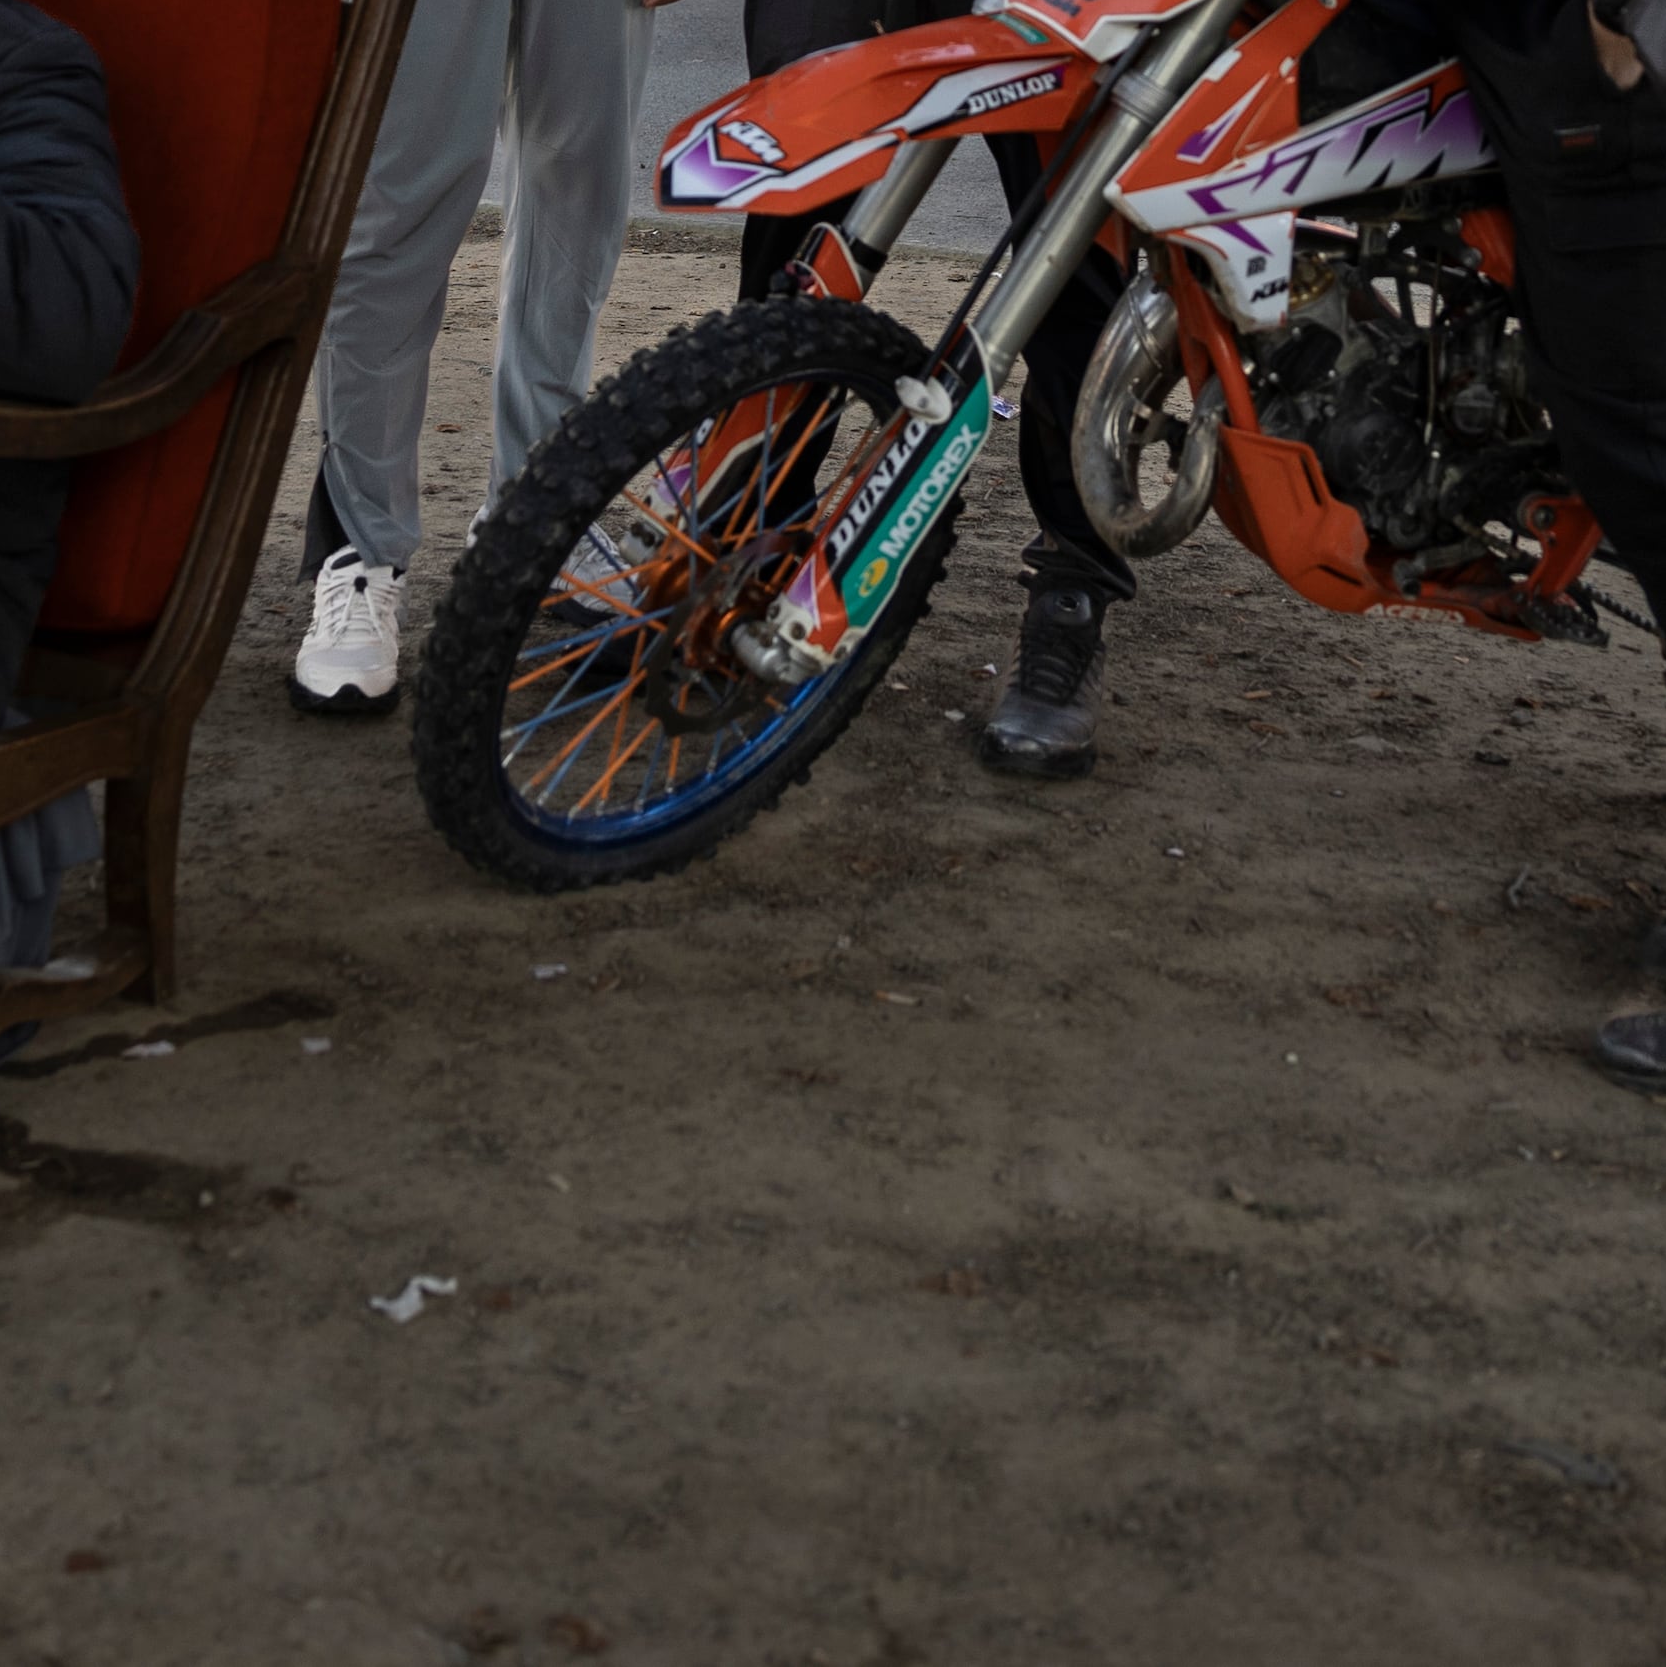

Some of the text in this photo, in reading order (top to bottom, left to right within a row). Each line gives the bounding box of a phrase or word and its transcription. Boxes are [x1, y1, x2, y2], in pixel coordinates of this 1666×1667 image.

[966, 72, 1058, 116] DUNLOP
[718, 120, 787, 165] KTM
[828, 416, 932, 560] DUNLO
[878, 422, 982, 559] MOTOREX
